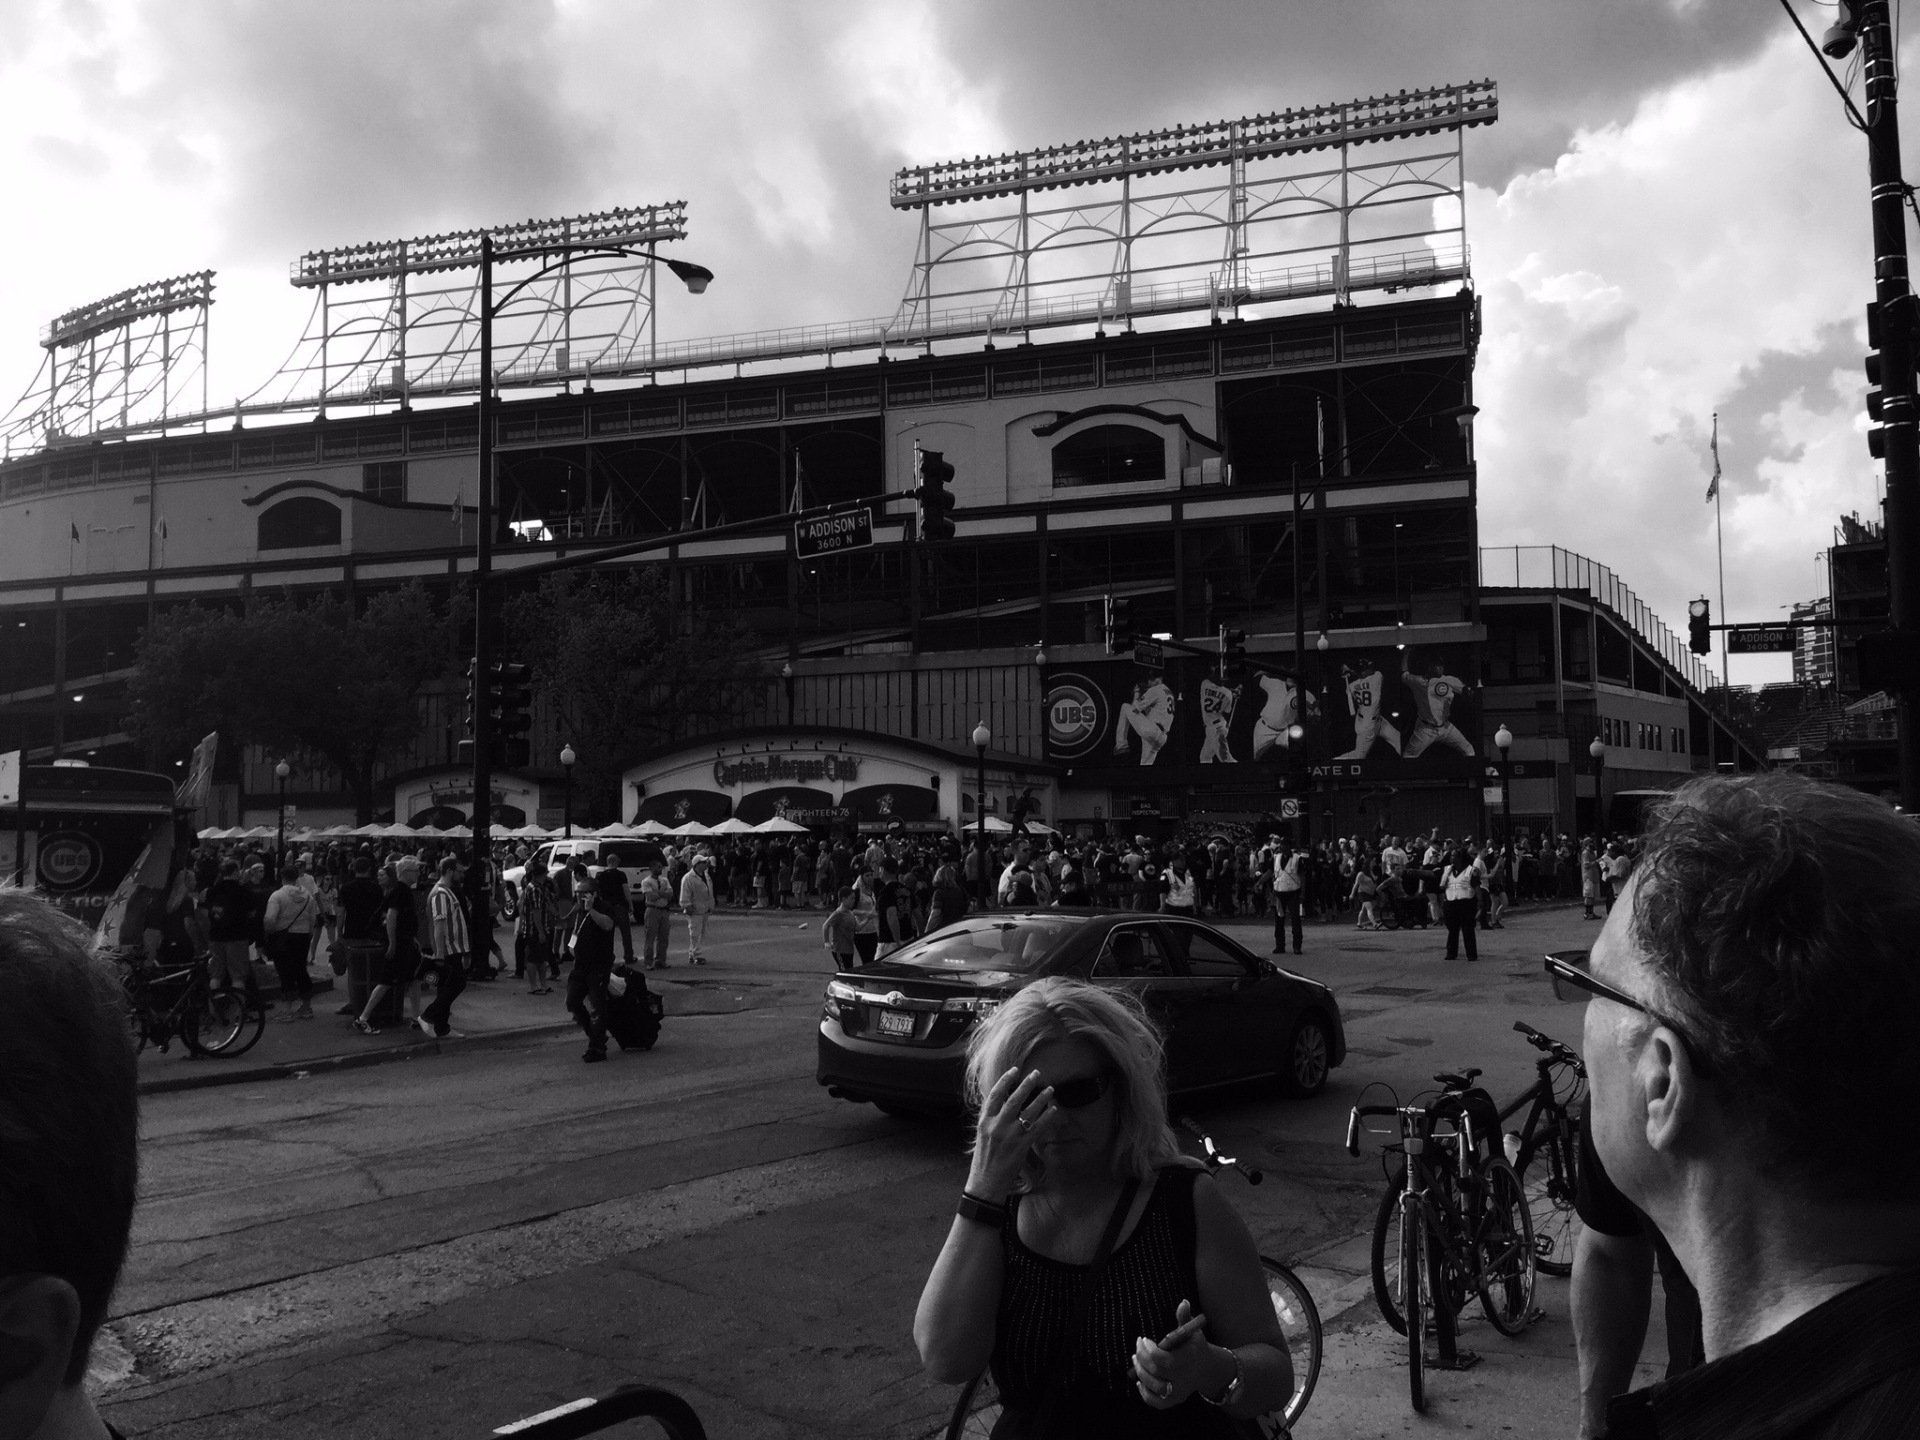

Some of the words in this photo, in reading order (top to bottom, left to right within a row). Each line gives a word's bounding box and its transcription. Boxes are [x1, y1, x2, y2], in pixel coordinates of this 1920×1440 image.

[799, 528, 806, 538] W
[809, 516, 856, 539] ADDISON
[858, 516, 868, 528] ST
[817, 537, 842, 550] 3600
[846, 534, 853, 545] N
[1739, 632, 1783, 643] ADDISON
[1204, 698, 1223, 712] 24
[1354, 691, 1372, 706] 68
[714, 757, 769, 788] Captain
[768, 754, 823, 784] Morgan
[824, 754, 862, 782] Club
[1350, 765, 1362, 776] D
